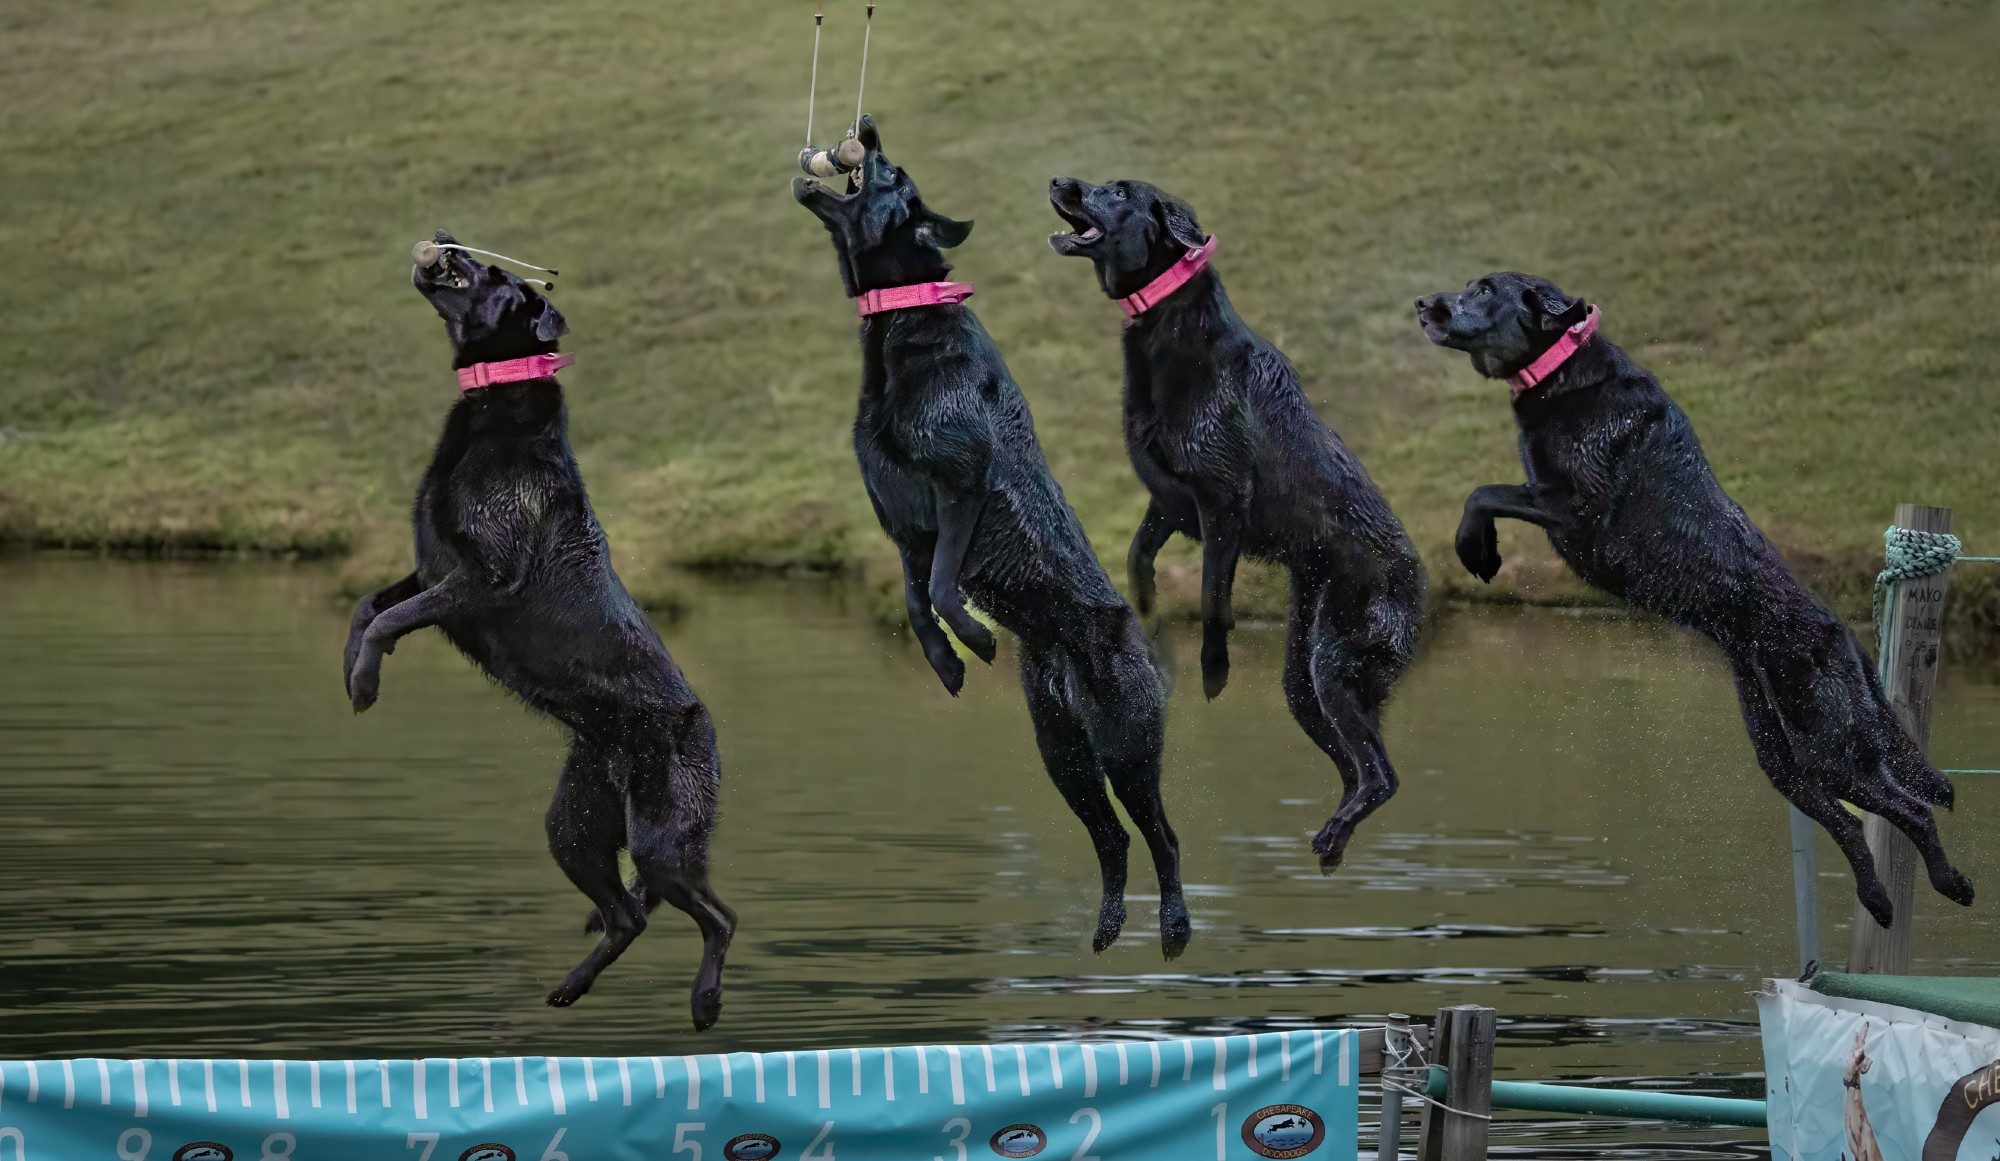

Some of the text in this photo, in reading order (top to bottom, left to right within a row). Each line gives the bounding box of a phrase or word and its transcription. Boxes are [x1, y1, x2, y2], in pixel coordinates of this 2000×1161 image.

[1908, 587, 1942, 603] MAKO
[1210, 1102, 1228, 1161] 1
[1256, 1104, 1314, 1120] CHESAPEAKE
[672, 1122, 706, 1161] 5
[799, 1120, 836, 1161] 4
[933, 1117, 972, 1161] 3
[1068, 1107, 1102, 1161] 2
[1262, 1146, 1308, 1159] DOCKDOGS
